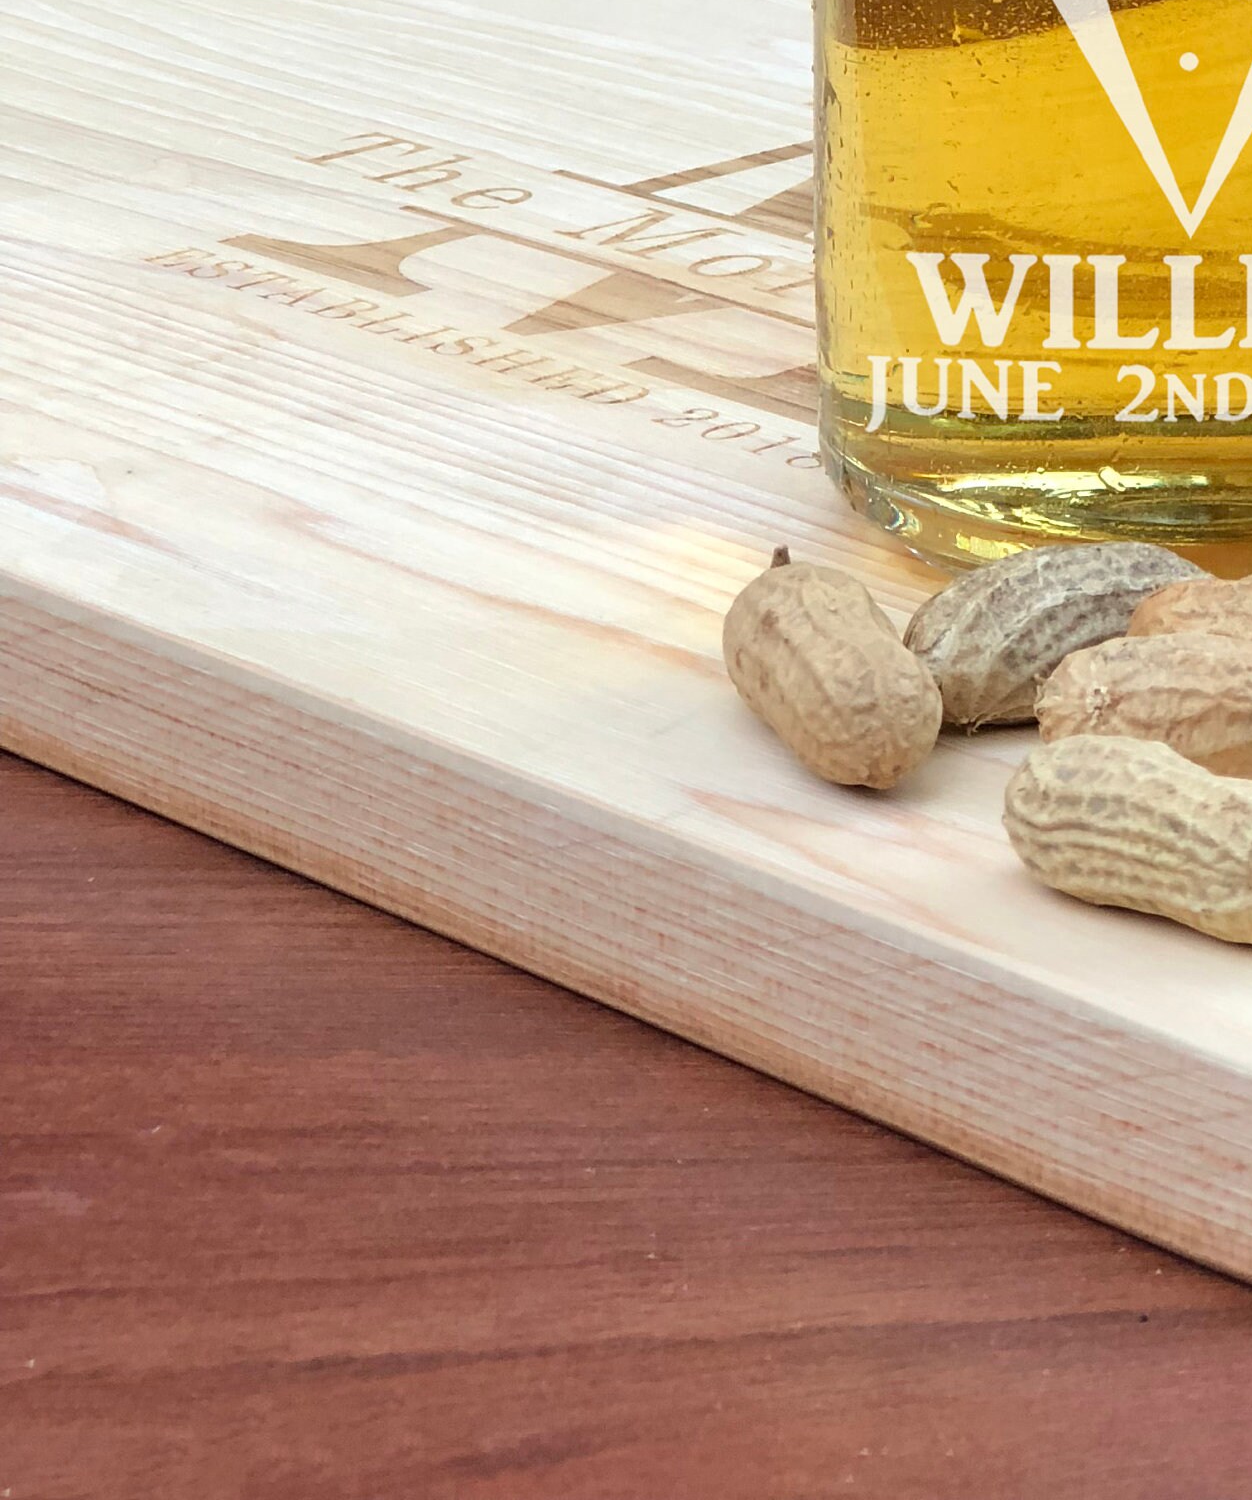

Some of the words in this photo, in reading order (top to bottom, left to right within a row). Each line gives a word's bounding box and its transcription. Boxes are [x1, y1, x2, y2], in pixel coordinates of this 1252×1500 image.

[294, 131, 533, 210] The
[144, 246, 650, 404] ESTABLISHED
[864, 354, 1063, 433] JUNE
